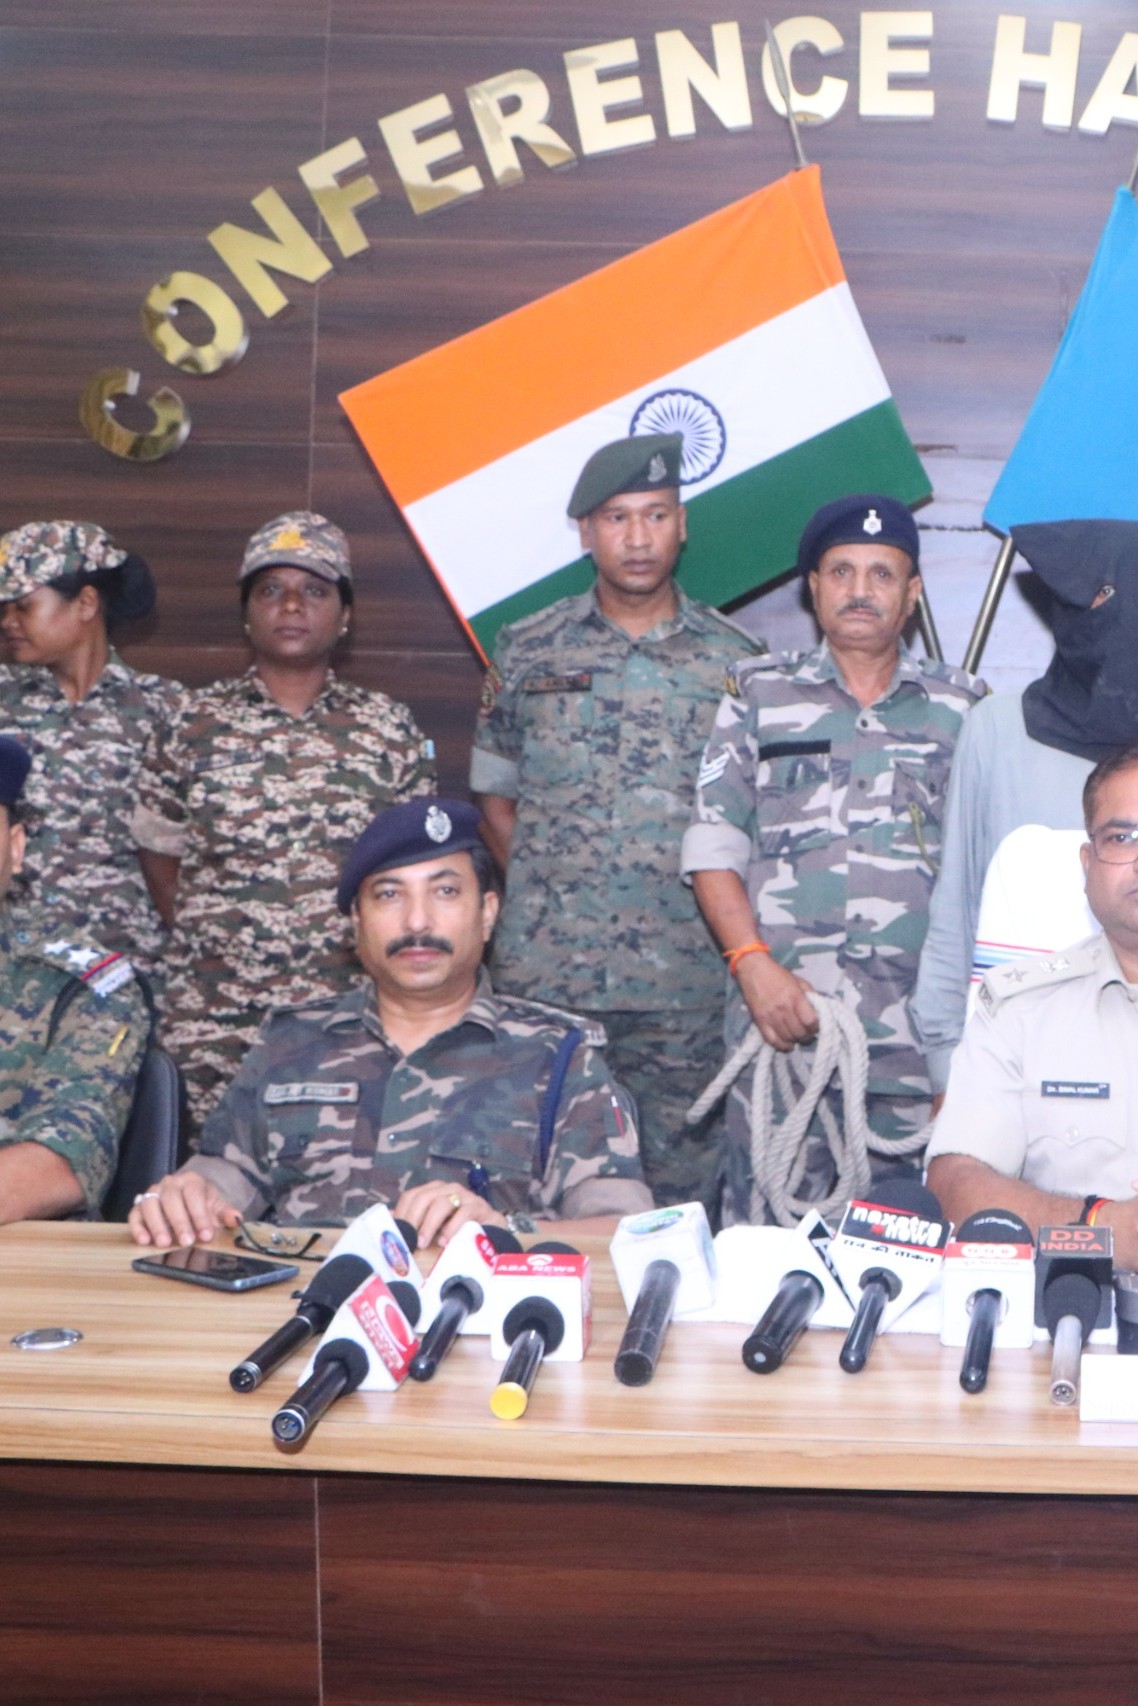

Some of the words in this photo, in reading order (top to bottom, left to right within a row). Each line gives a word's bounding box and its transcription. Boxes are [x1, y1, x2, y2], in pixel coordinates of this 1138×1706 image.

[78, 10, 935, 462] CONFERENCE
[1050, 1229, 1095, 1242] DD
[1041, 1241, 1104, 1251] INDIA
[532, 1265, 576, 1273] NEWS
